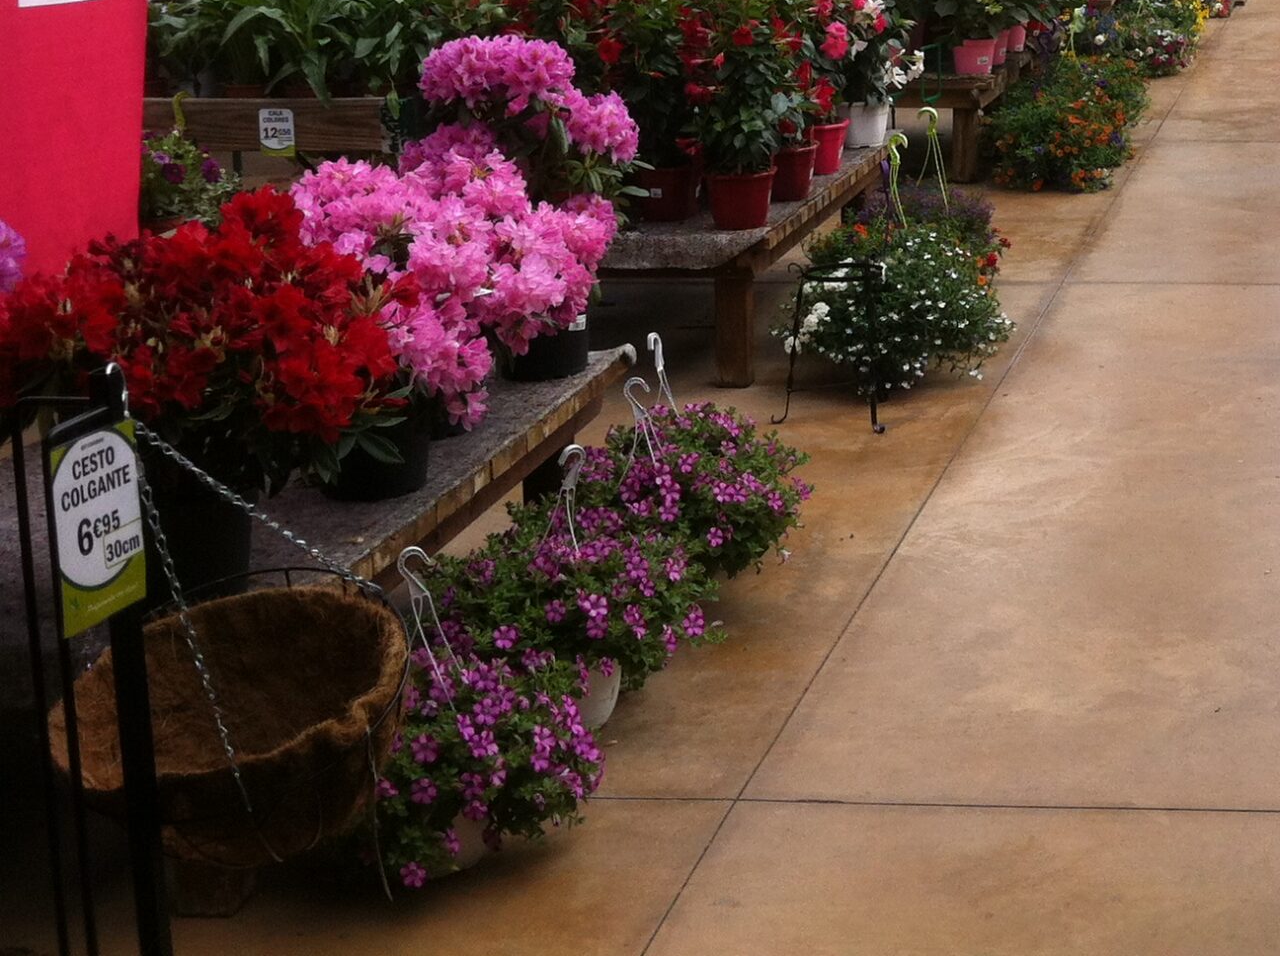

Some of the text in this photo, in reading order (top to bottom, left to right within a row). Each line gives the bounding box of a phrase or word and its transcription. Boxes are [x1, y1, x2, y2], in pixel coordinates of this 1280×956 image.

[72, 446, 115, 481] CESTO
[61, 464, 132, 512] COLGANTE
[77, 509, 121, 556] 6€95
[105, 534, 140, 563] 30cm
